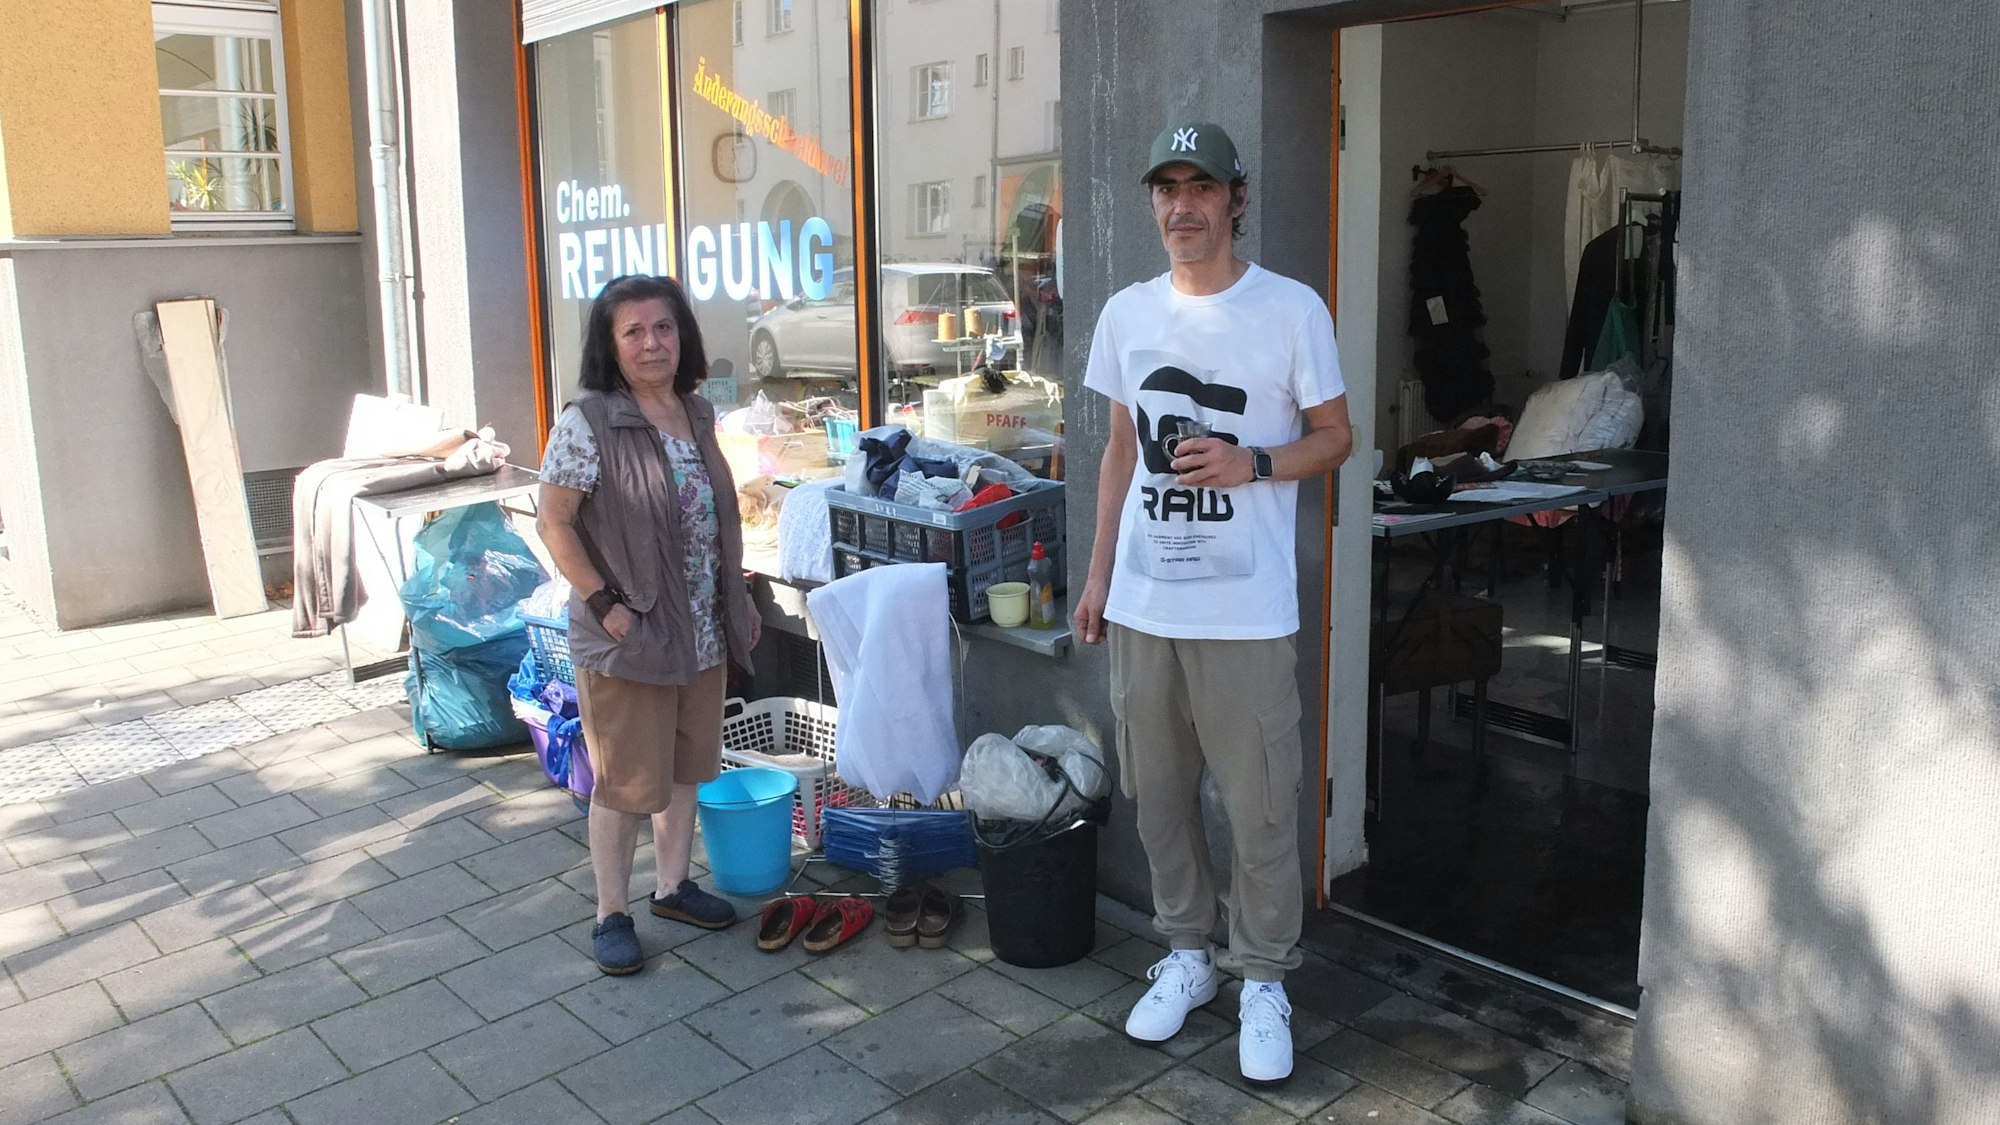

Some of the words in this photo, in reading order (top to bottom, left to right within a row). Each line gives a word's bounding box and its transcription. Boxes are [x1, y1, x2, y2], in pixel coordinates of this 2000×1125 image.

[1171, 127, 1198, 152] NY
[556, 179, 631, 224] Chem.
[558, 216, 834, 301] REINIGUNG
[986, 413, 1028, 429] PFAFF
[1141, 486, 1234, 521] RAW
